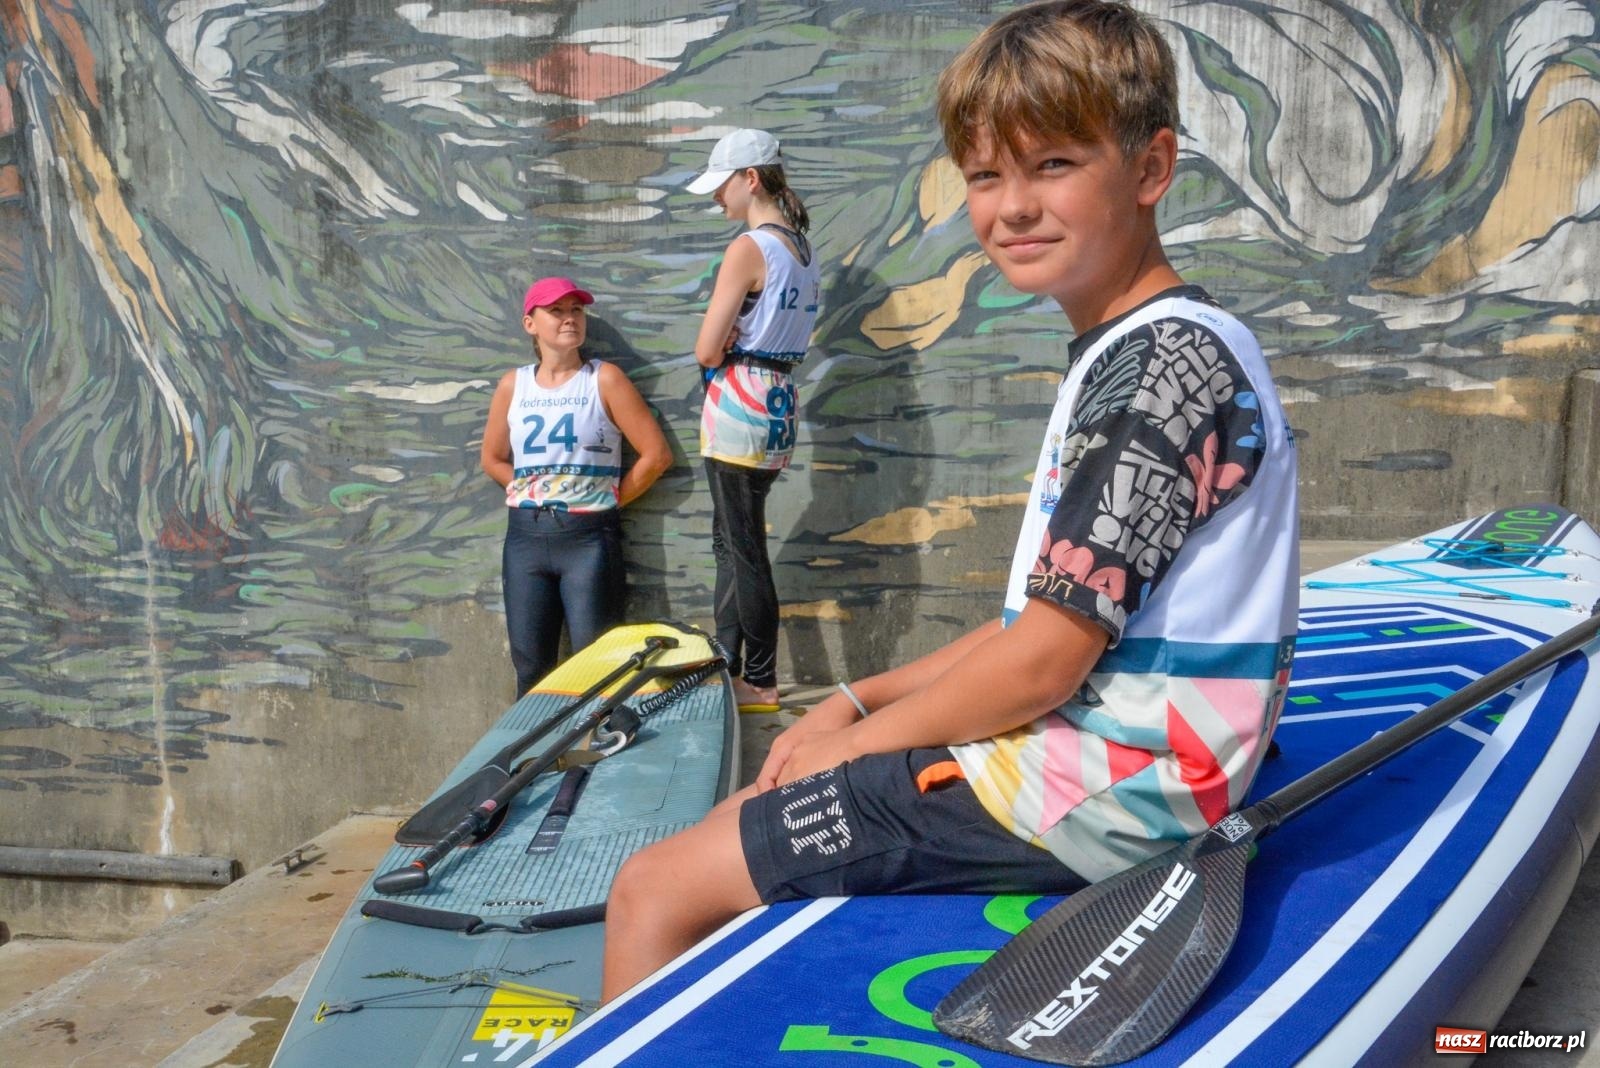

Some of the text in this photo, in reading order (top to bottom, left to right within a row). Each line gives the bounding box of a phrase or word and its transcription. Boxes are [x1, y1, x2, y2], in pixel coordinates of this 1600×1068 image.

[780, 287, 800, 310] 12
[522, 412, 578, 455] 24
[780, 768, 853, 856] UP
[482, 1018, 571, 1029] RACE
